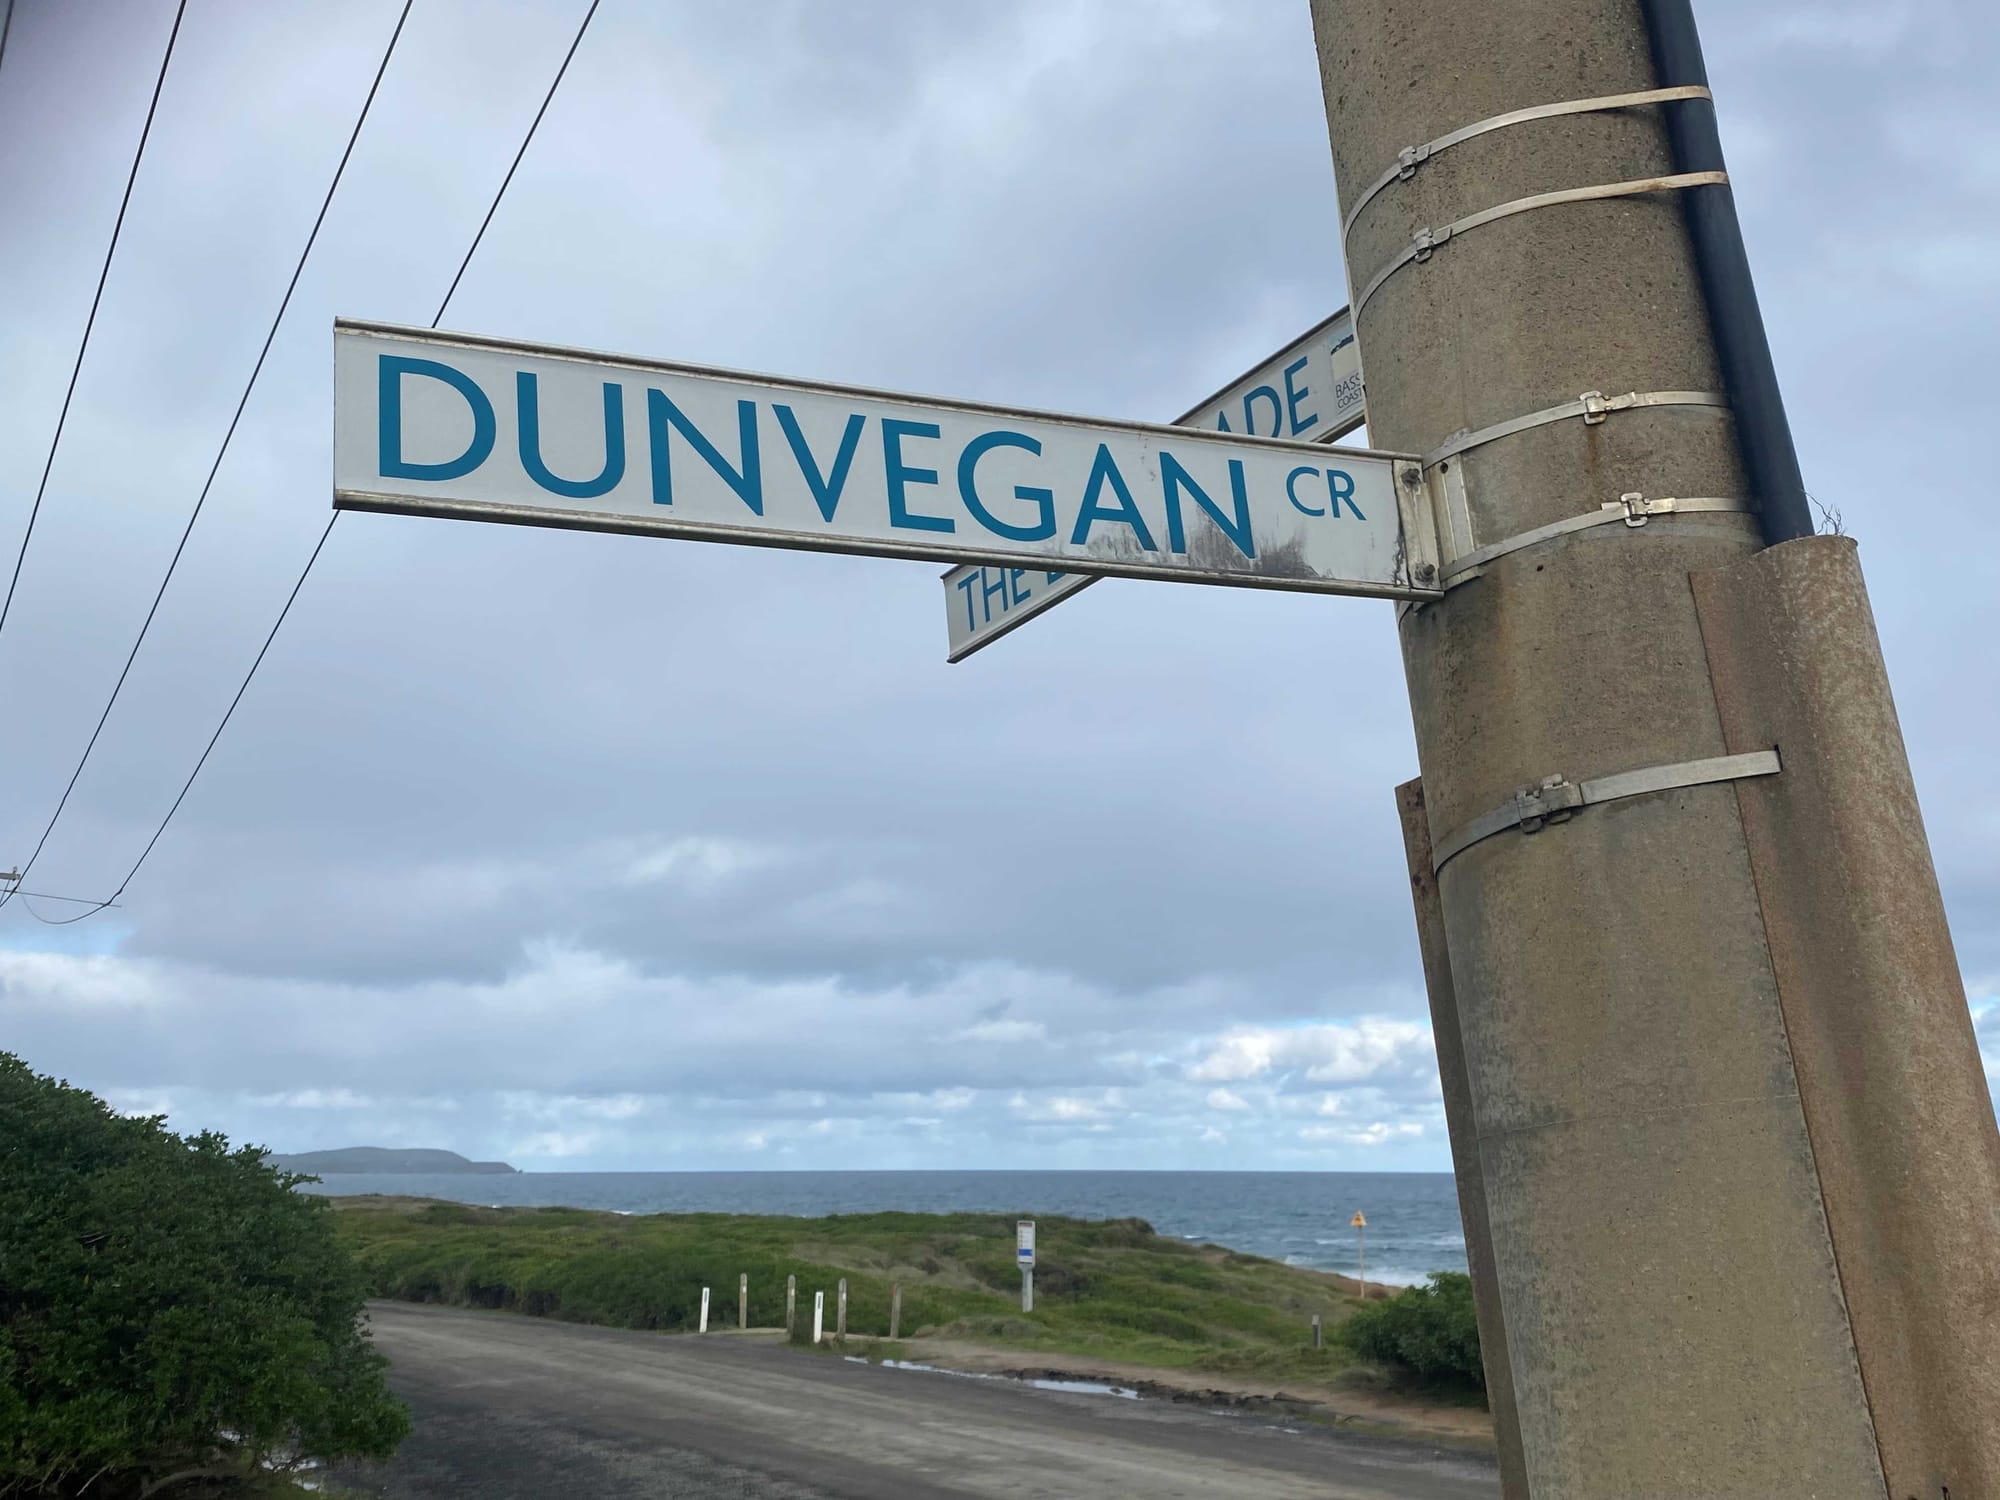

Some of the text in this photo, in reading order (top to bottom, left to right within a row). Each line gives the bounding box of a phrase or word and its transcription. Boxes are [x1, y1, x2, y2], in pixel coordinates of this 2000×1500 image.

[379, 354, 1367, 559] DUNVEGAN CR
[957, 566, 1031, 633] THE
